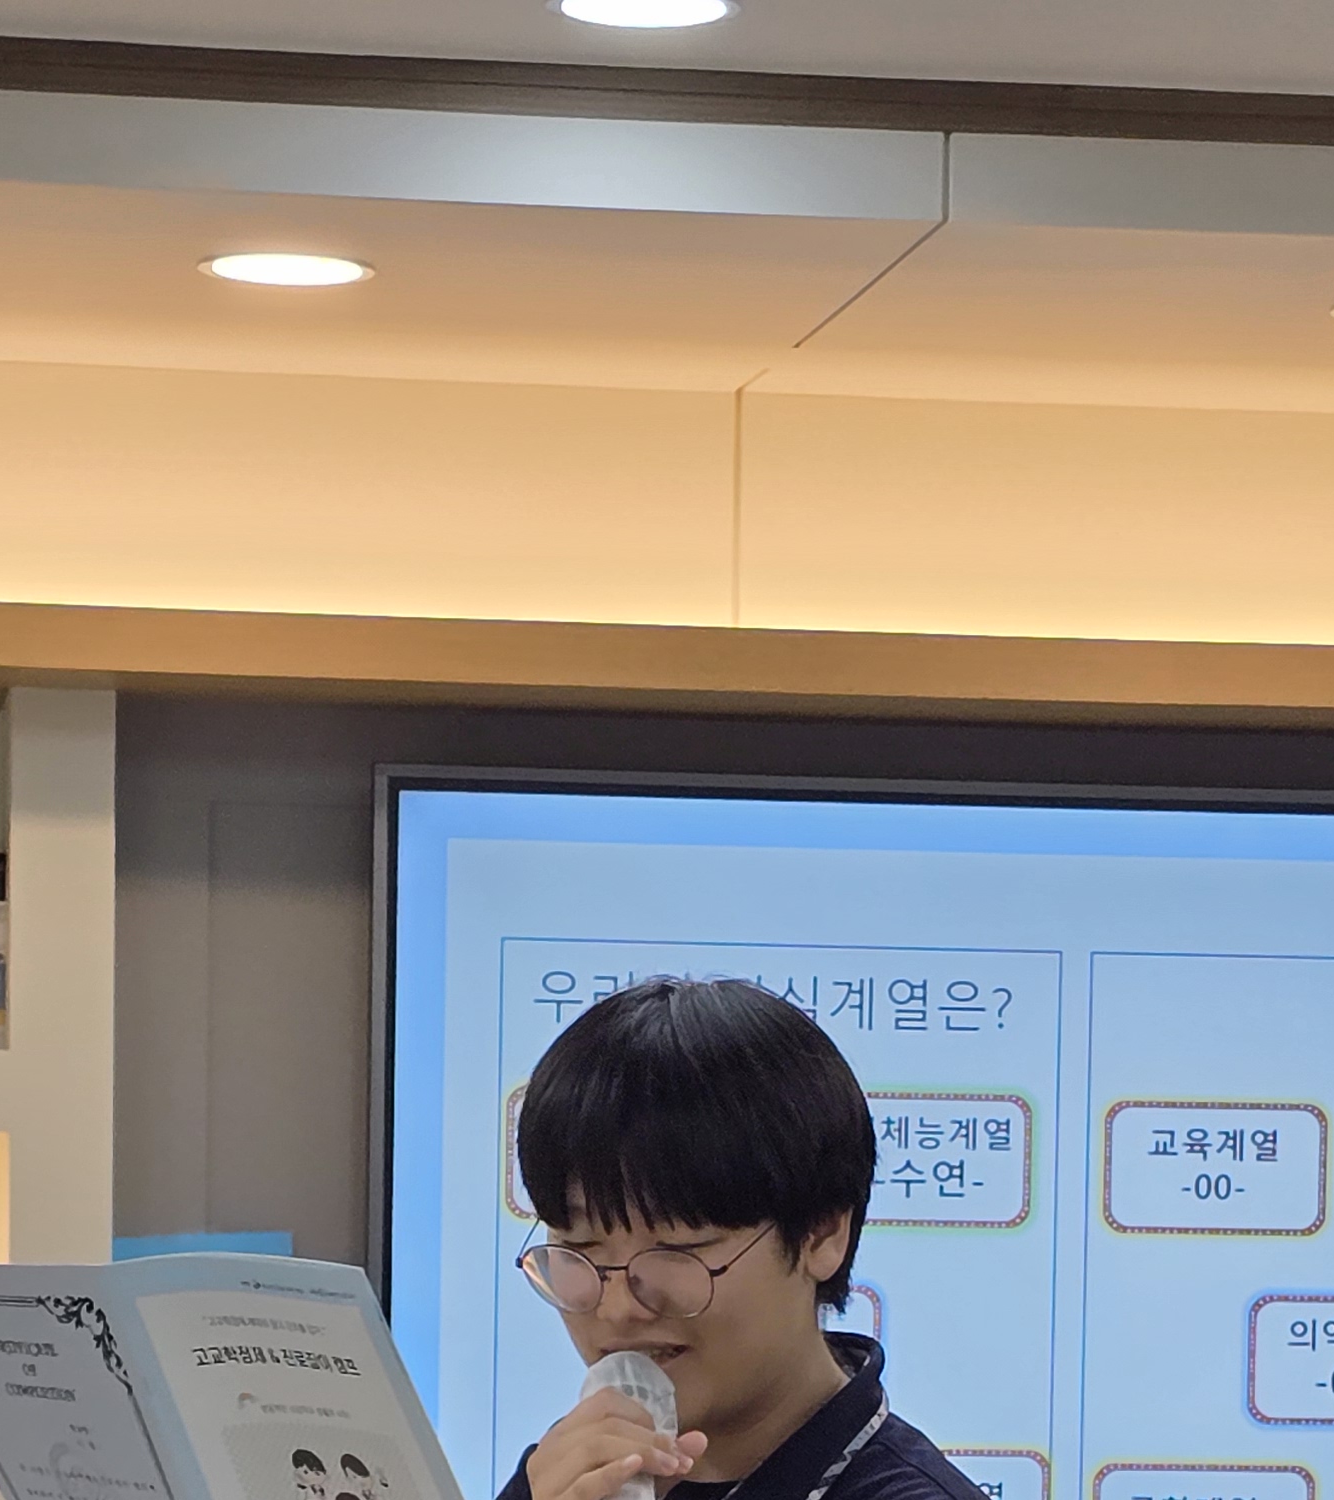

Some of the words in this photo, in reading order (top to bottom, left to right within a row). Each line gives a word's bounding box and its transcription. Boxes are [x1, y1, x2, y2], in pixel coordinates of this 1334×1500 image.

[756, 974, 1014, 1034] 심계열은?
[871, 1115, 1012, 1152] 체능계열
[1147, 1127, 1280, 1164] 교육계열
[872, 1158, 985, 1199] -수연-
